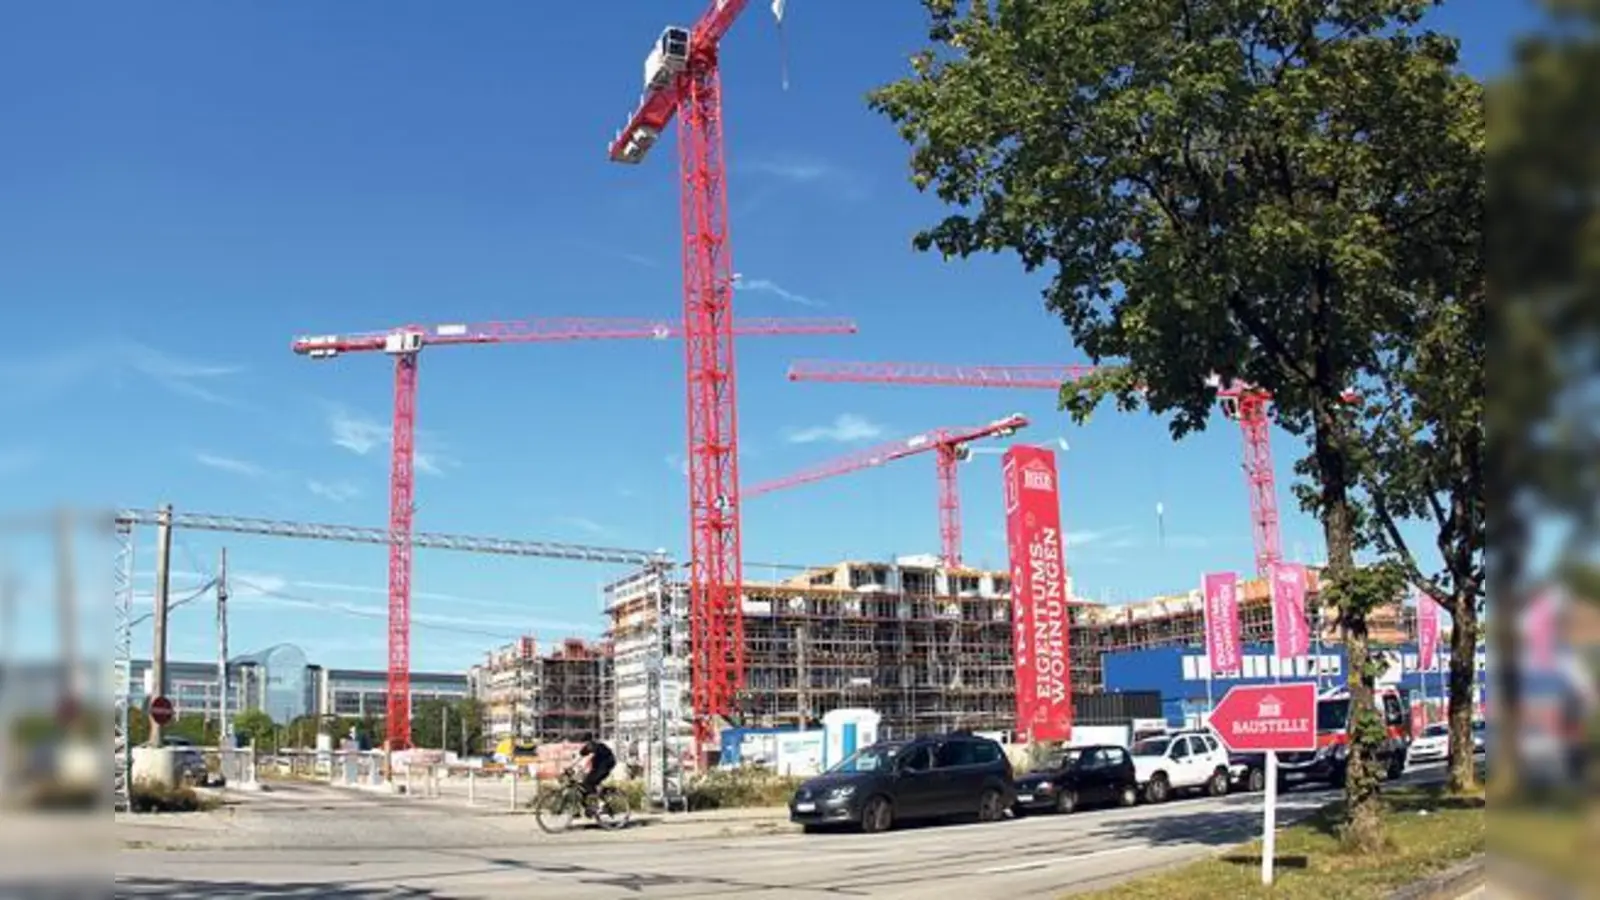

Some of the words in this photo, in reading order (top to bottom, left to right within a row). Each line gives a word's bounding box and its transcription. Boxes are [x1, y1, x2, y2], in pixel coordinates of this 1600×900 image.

[1029, 533, 1051, 698] EIGENTUMS-
[1042, 526, 1065, 704] WOHNUNGEN
[1231, 718, 1310, 735] BAUSTELLE
